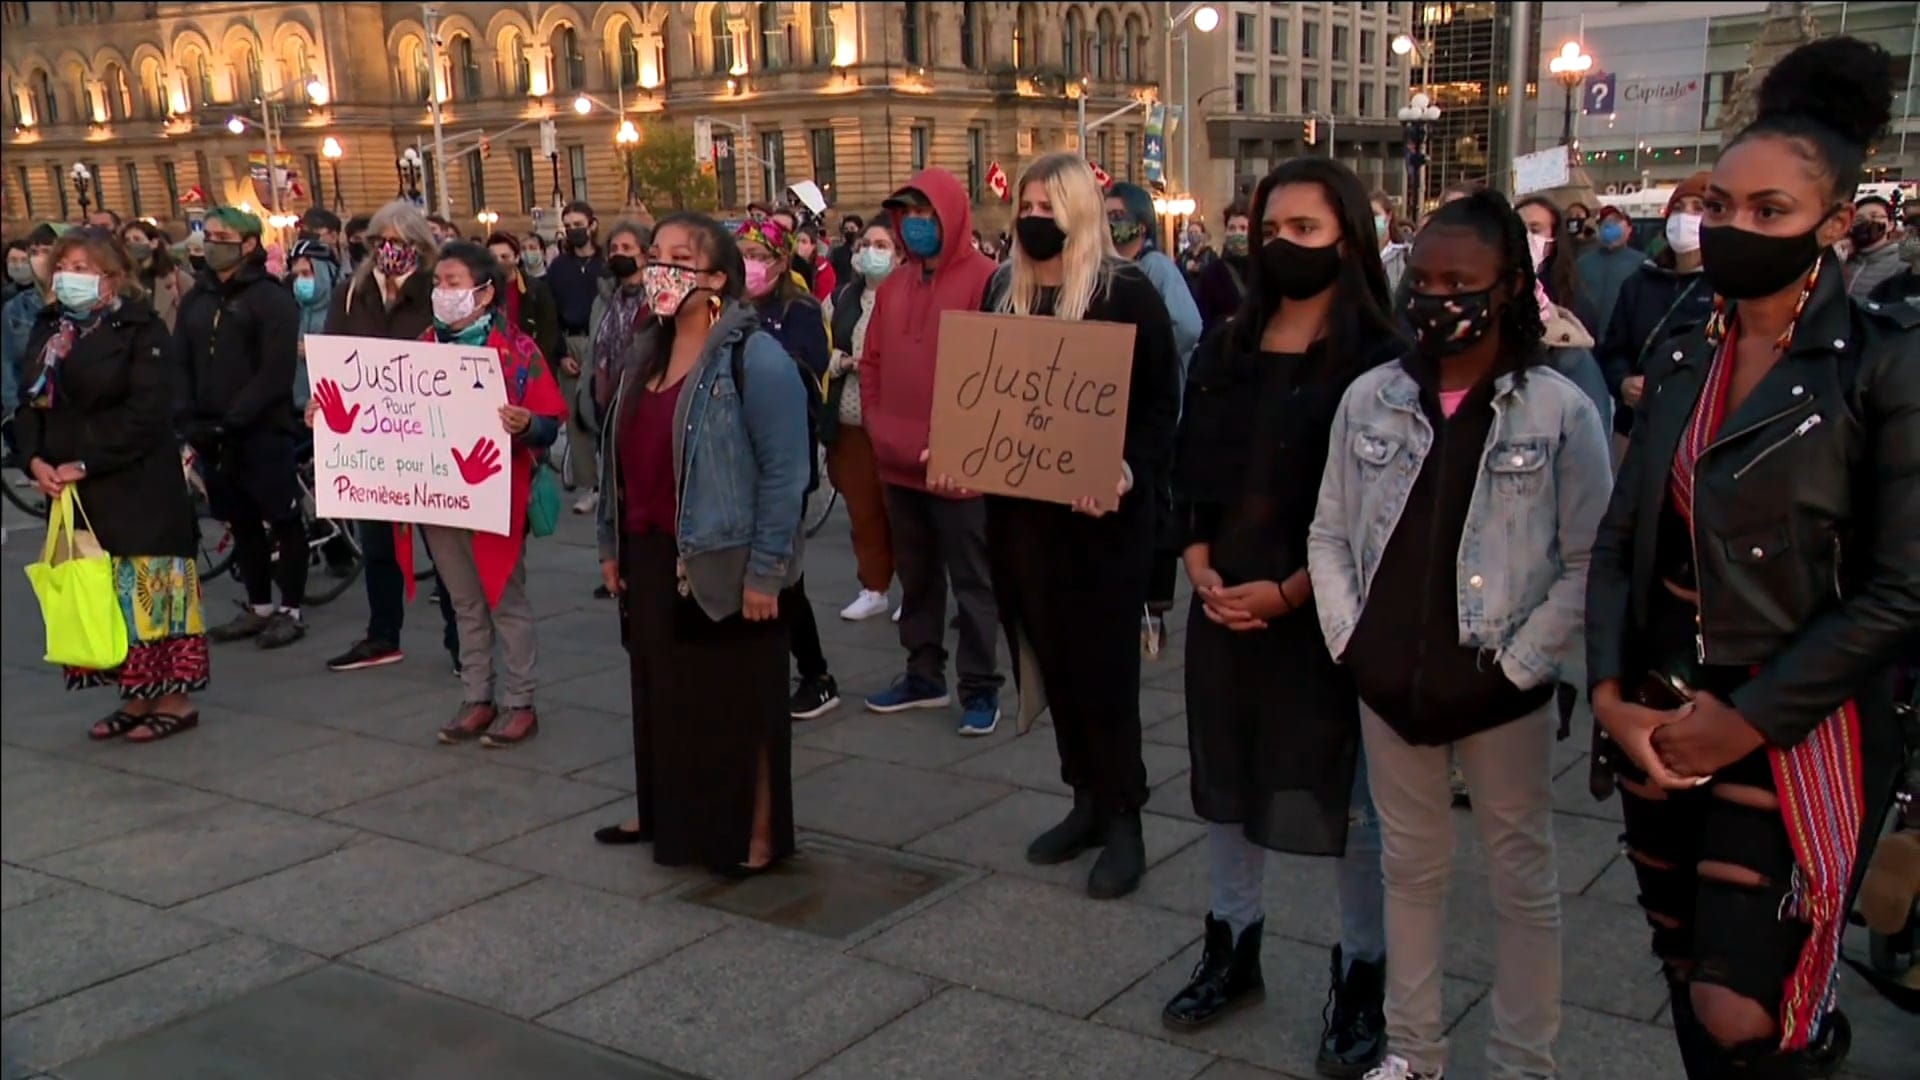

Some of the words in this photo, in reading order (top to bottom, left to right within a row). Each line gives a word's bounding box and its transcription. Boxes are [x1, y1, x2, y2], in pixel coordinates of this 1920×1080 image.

[957, 327, 1116, 416] Justice
[361, 403, 423, 442] Joyce
[1025, 406, 1053, 431] for
[396, 458, 423, 477] pour
[430, 451, 449, 476] les
[962, 409, 1075, 487] Joyce
